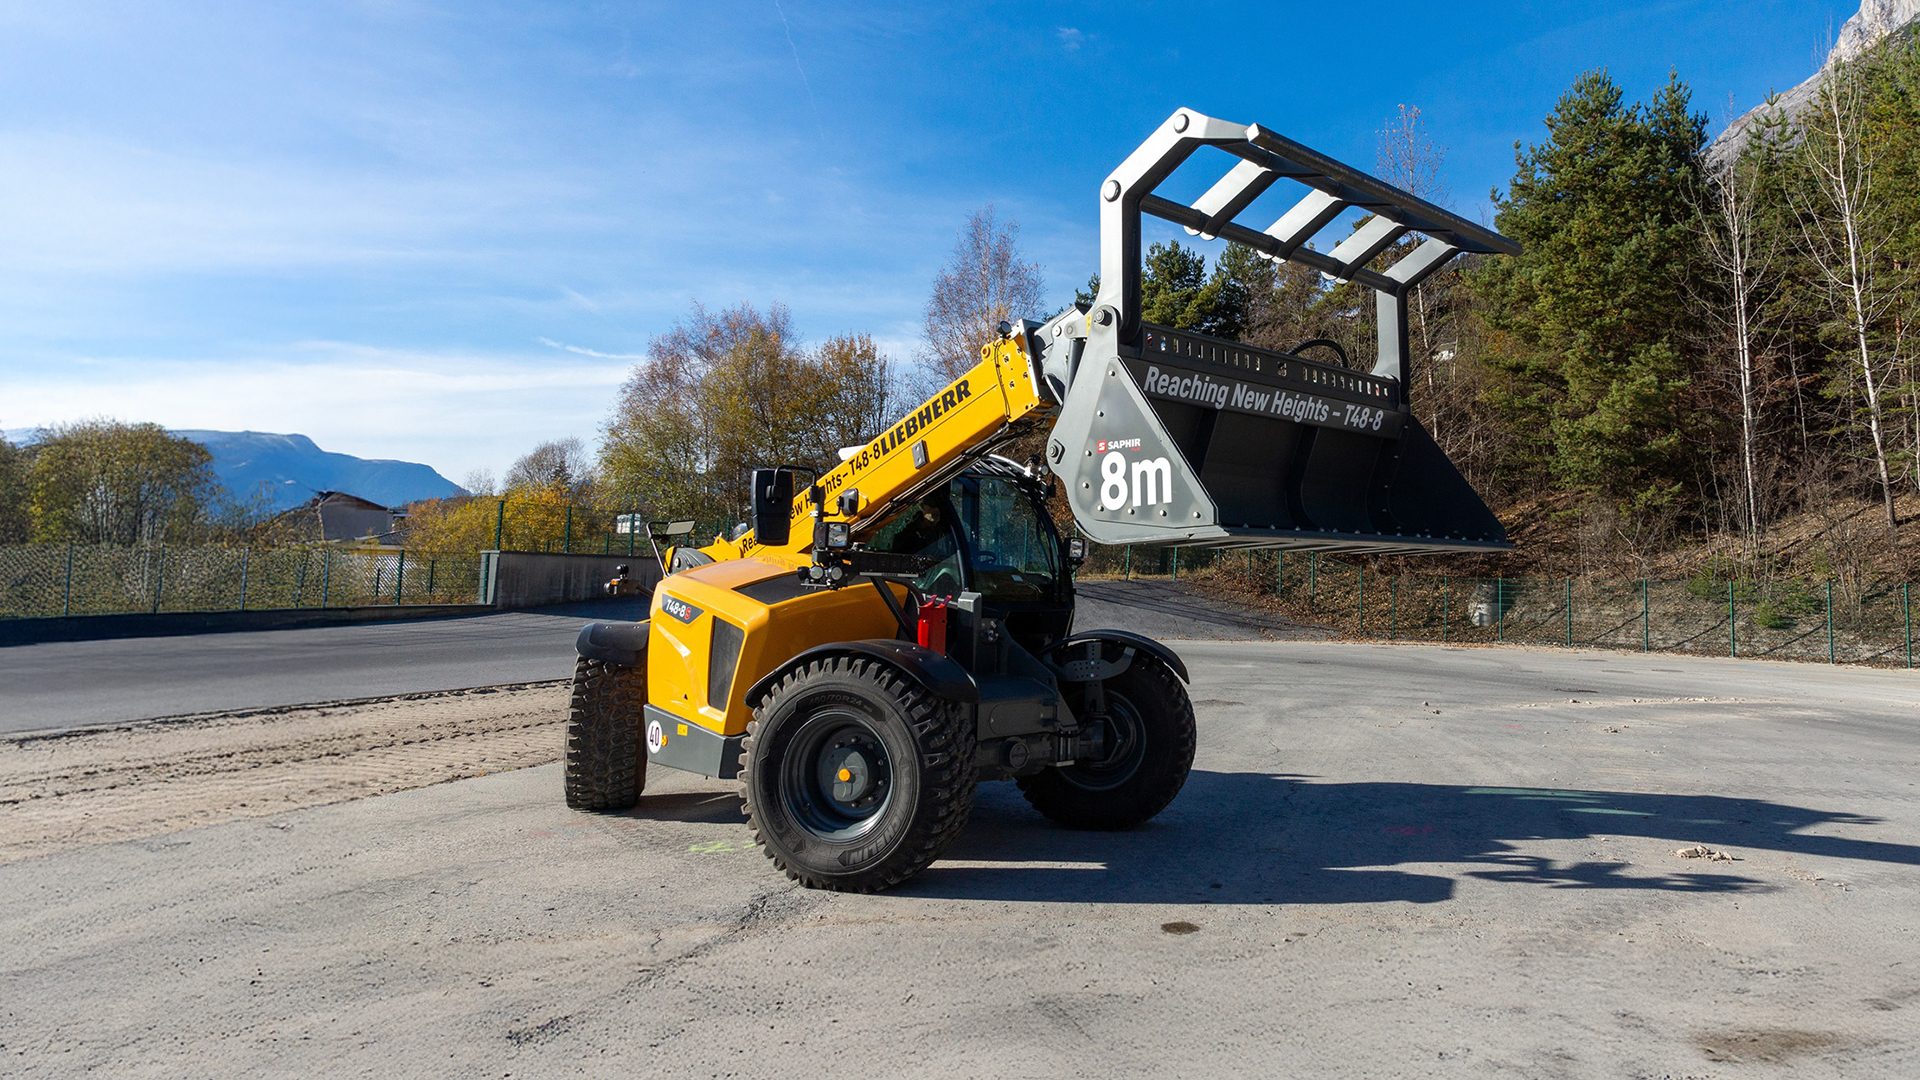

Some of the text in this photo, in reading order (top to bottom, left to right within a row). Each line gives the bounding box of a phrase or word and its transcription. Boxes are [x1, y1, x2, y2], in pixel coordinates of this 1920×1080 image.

[880, 379, 972, 456] LIEBHERR
[1143, 365, 1229, 410] Reaching
[1230, 383, 1270, 412] New
[1270, 390, 1329, 423] Heights
[1343, 404, 1384, 431] T48-8
[1107, 438, 1141, 450] SAPHIR
[790, 498, 804, 520] ew
[805, 475, 843, 510] Hhts
[848, 441, 881, 477] T48-8
[1100, 451, 1172, 511] 8m
[649, 725, 660, 747] 40
